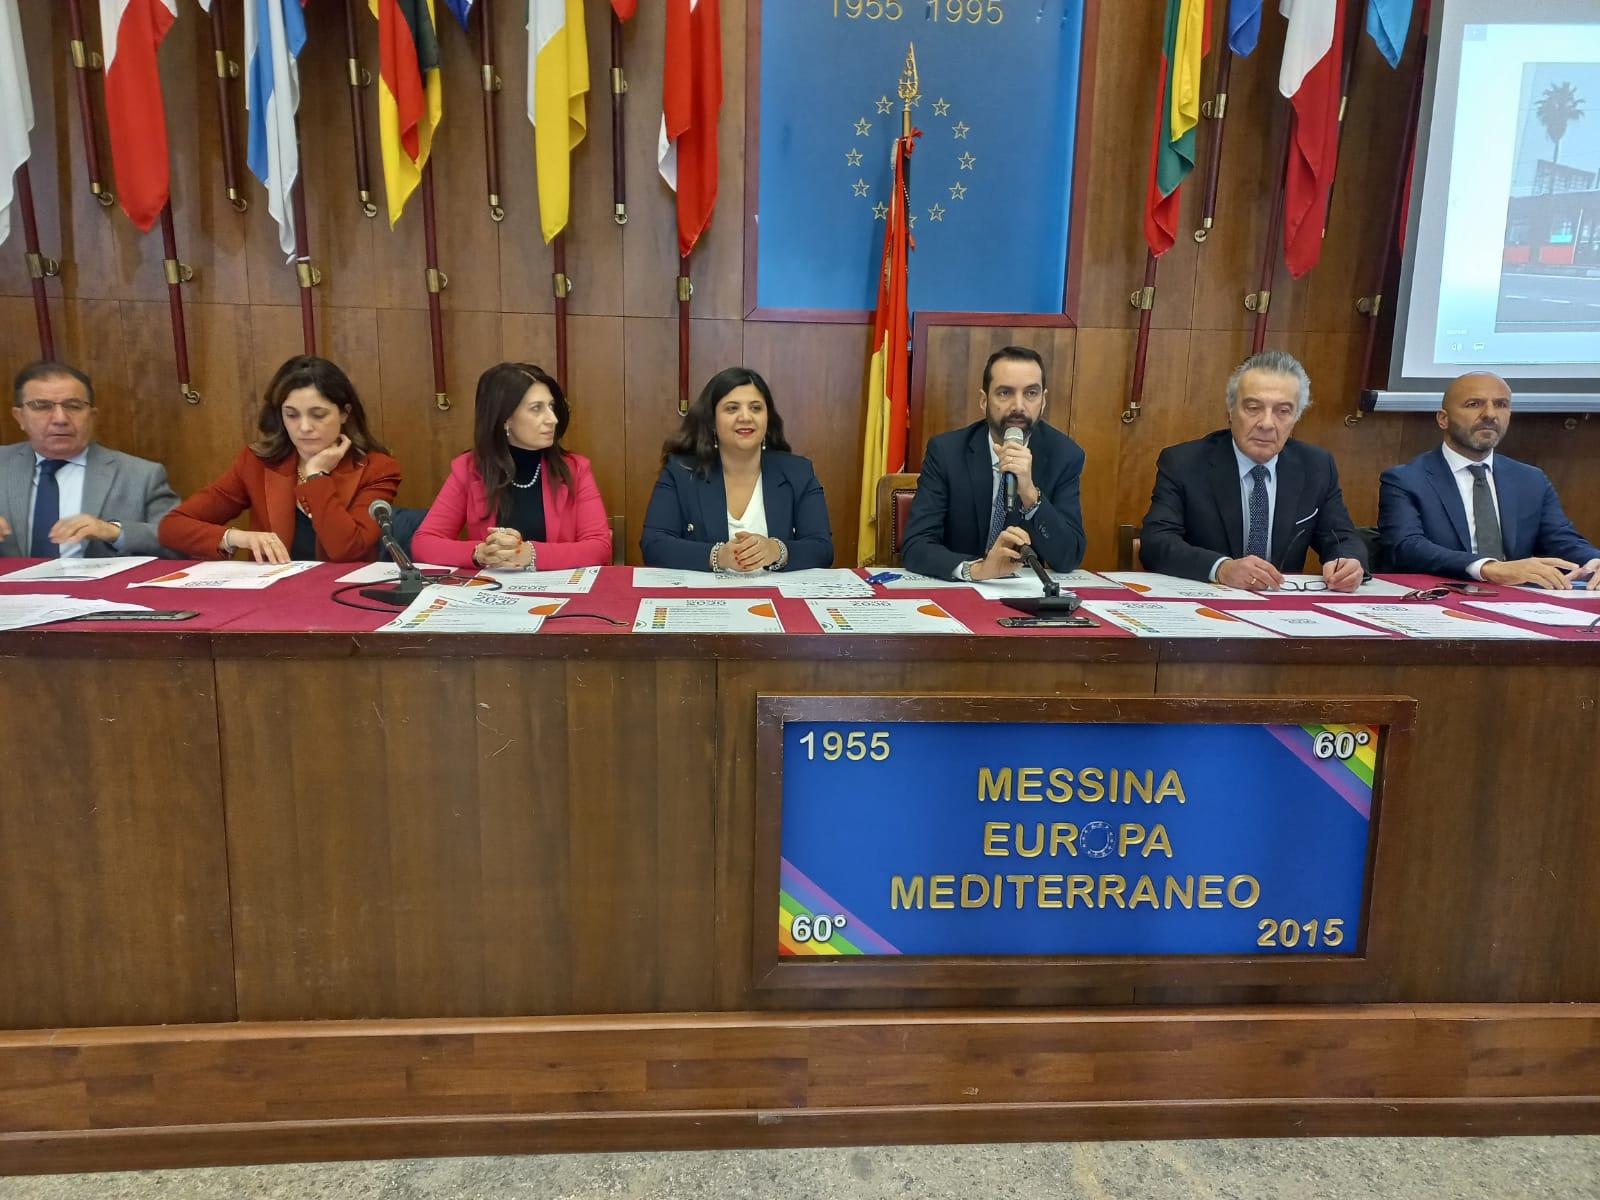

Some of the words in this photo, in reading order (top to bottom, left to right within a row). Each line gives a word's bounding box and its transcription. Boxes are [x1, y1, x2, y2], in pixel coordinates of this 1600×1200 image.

[832, 0, 903, 21] 1955
[927, 0, 1004, 25] 1995
[799, 731, 891, 761] 1955
[1313, 731, 1370, 760] 60°
[976, 766, 1186, 804] MESSINA
[982, 820, 1174, 859] EUROPA
[890, 873, 1261, 910] MEDITERRANEO
[791, 914, 848, 943] 60°
[1256, 918, 1346, 948] 2015
